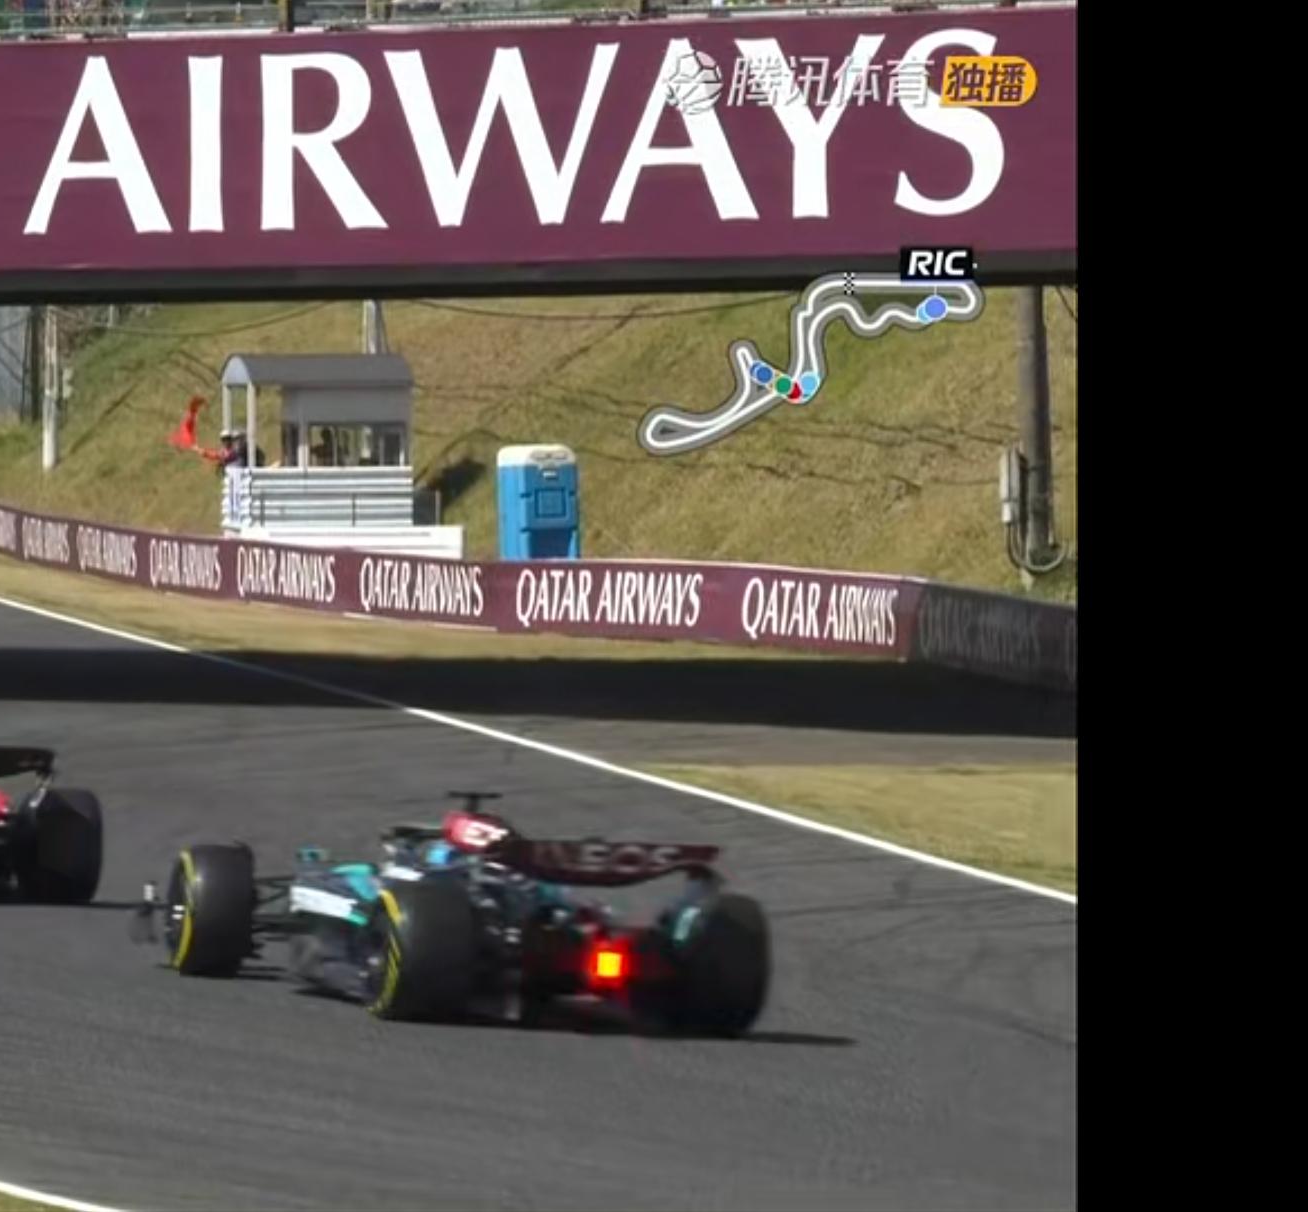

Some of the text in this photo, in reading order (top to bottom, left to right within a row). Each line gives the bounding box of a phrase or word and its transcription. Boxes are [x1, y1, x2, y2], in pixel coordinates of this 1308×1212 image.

[24, 28, 1005, 235] AIRWAYS
[237, 546, 275, 597] QATAR
[360, 557, 484, 616] QATAR AIRWAYS
[516, 569, 703, 627] QATAR AIRWAYS
[742, 577, 898, 646] QATAR AIRWAYS
